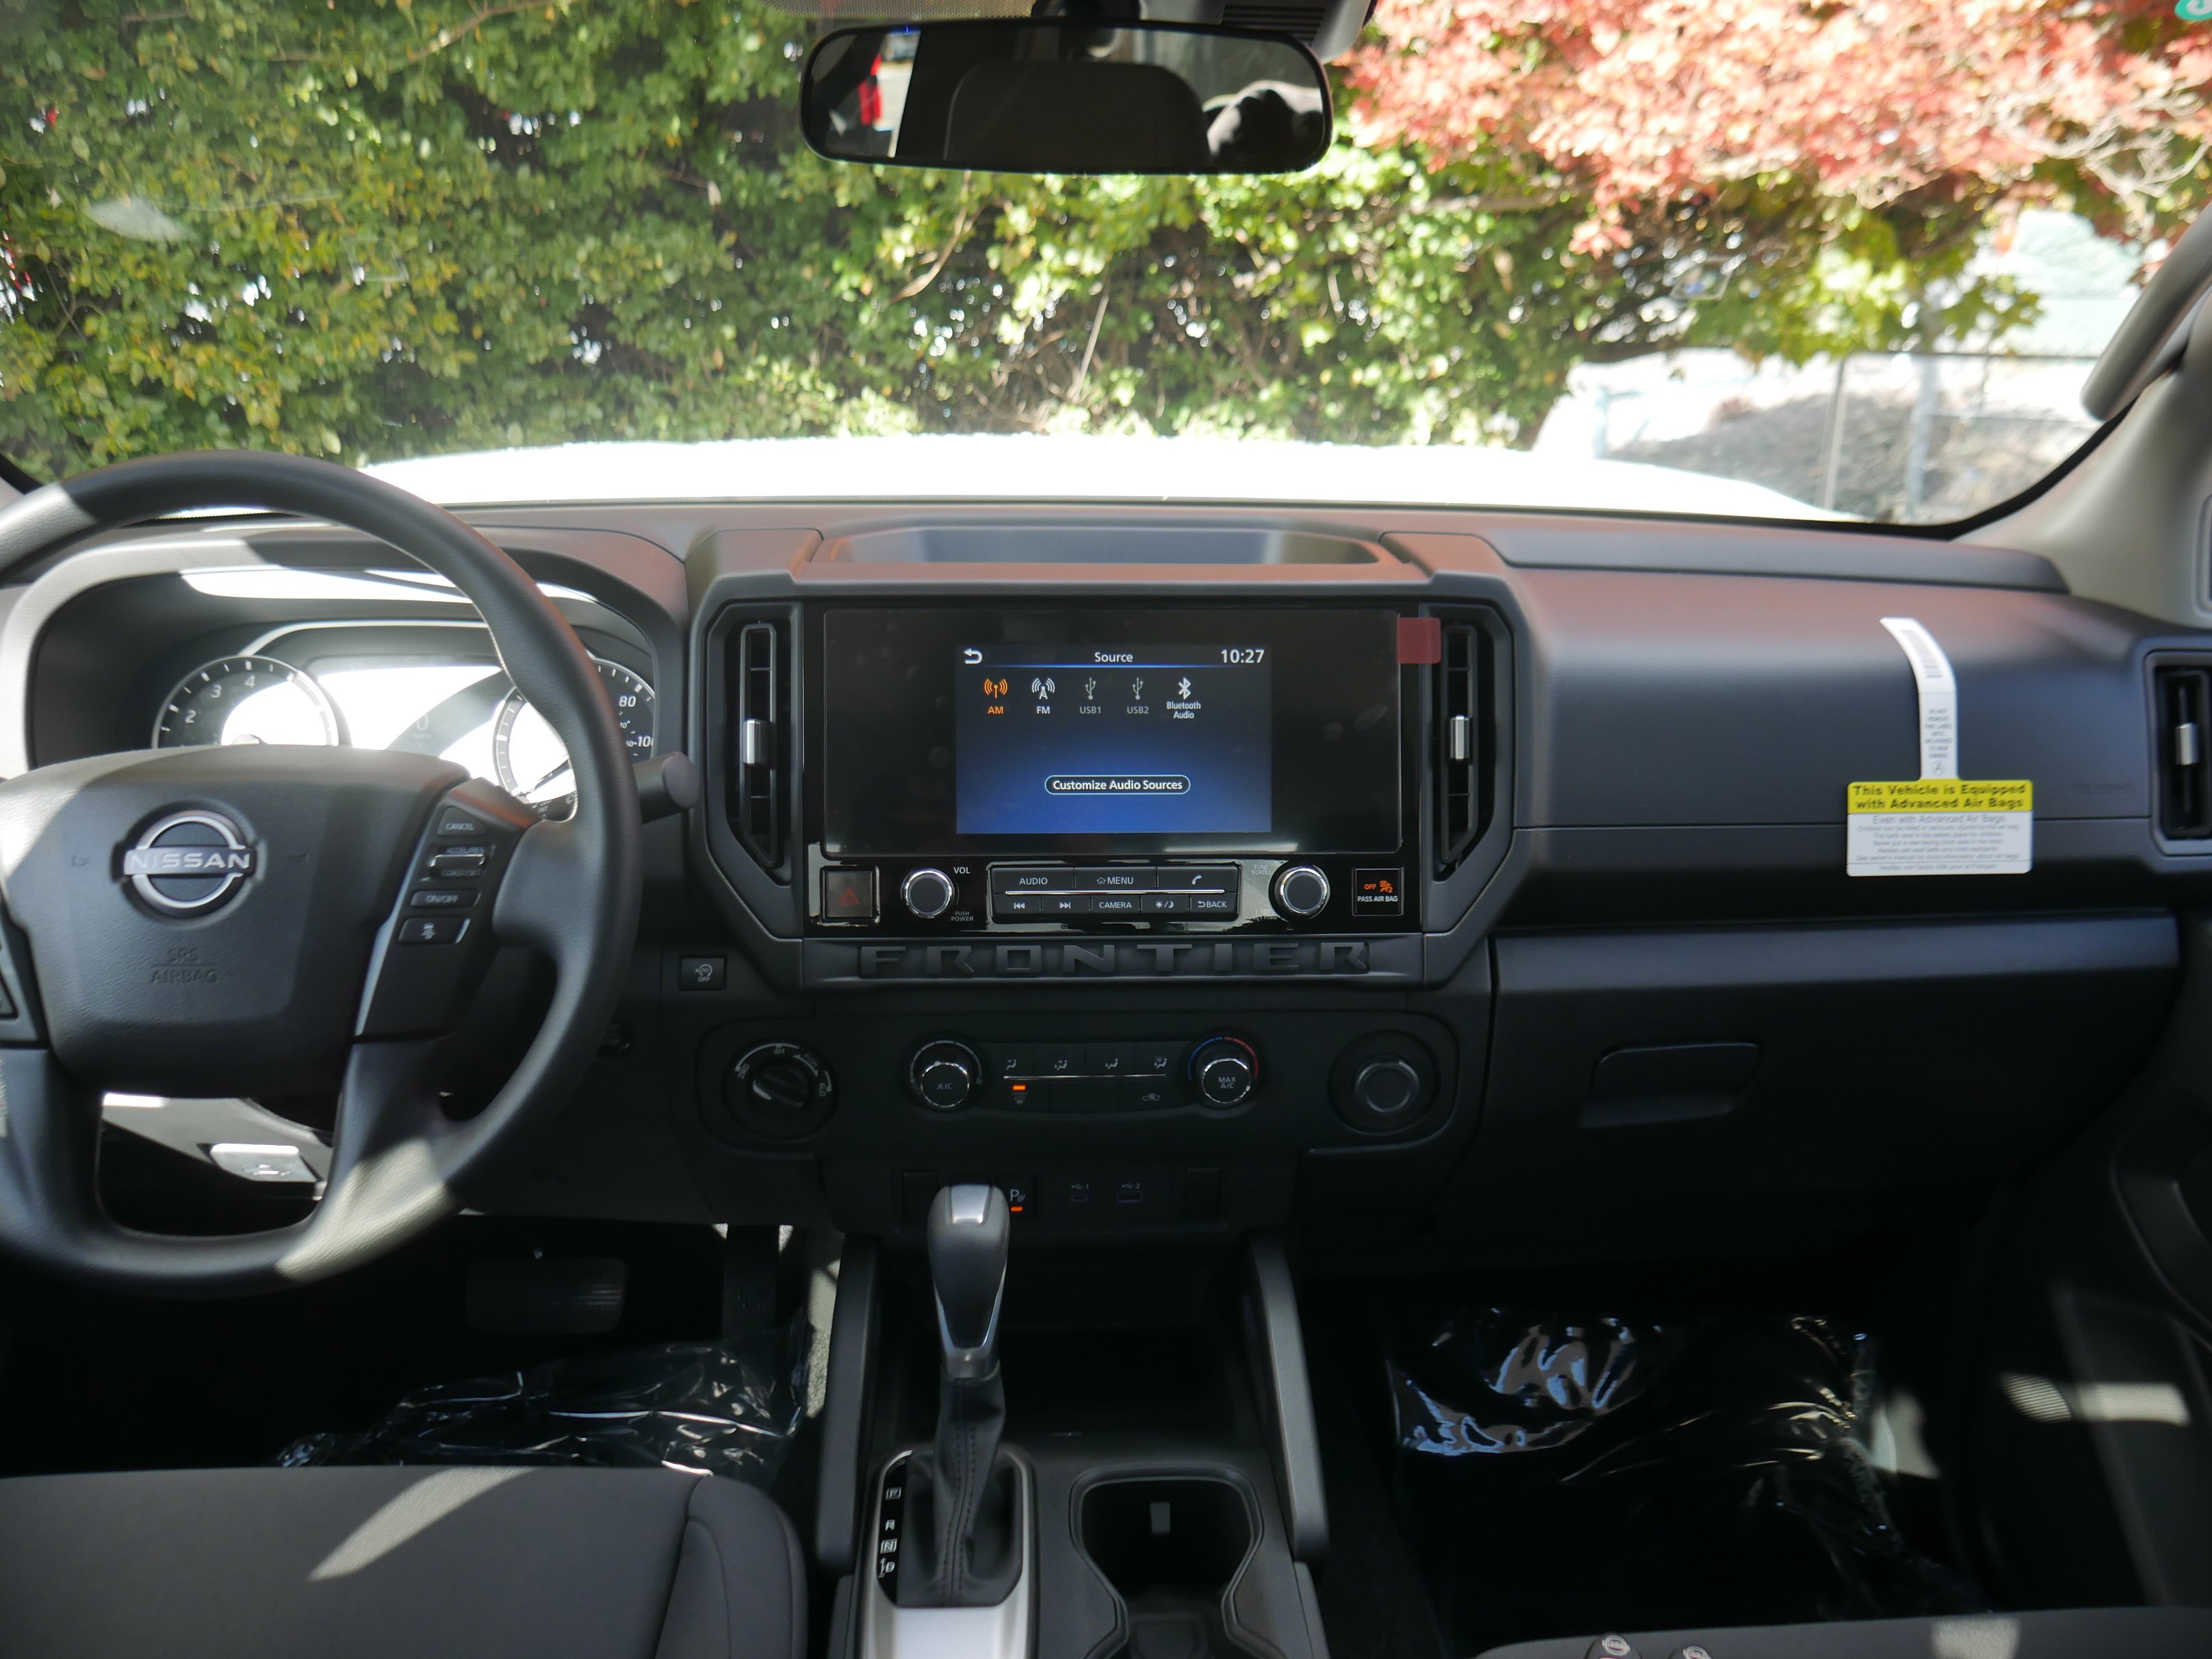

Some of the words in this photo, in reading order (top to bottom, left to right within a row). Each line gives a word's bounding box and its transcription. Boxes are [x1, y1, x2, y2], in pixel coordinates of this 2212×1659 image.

[1094, 652, 1133, 663] Source
[1220, 648, 1265, 664] 10:27
[244, 674, 256, 689] 4
[211, 684, 222, 698] 3
[618, 695, 637, 708] 80
[1166, 701, 1202, 710] Bluetooth
[988, 706, 1004, 715] AM
[1036, 706, 1051, 715] FM
[1079, 706, 1102, 715] USB1
[1127, 706, 1149, 715] USB2
[1173, 710, 1195, 719] Audio
[184, 709, 197, 723] 2
[1053, 780, 1107, 790] Customize
[1109, 780, 1142, 790] Audio
[1143, 780, 1183, 790] Sources
[1853, 785, 1883, 795] This
[1888, 784, 1939, 795] Vehicle
[1943, 784, 1956, 795] is
[1960, 783, 2027, 797] Equipped
[1855, 798, 1886, 810] with
[1890, 798, 1959, 809] Advanced
[1963, 797, 1984, 808] Air
[1988, 797, 2024, 810] Bags
[445, 823, 476, 831] CANCEL
[129, 852, 251, 869] NISSAN
[953, 866, 971, 875] VOL
[1019, 877, 1049, 886] AUDIO
[1107, 876, 1135, 885] MENU
[1098, 901, 1133, 909] CAMERA
[1205, 901, 1228, 909] BACK
[860, 942, 1369, 974] FRONTIER
[150, 968, 218, 984] AIRBAG
[1009, 1188, 1020, 1202] P
[885, 1519, 896, 1531] R
